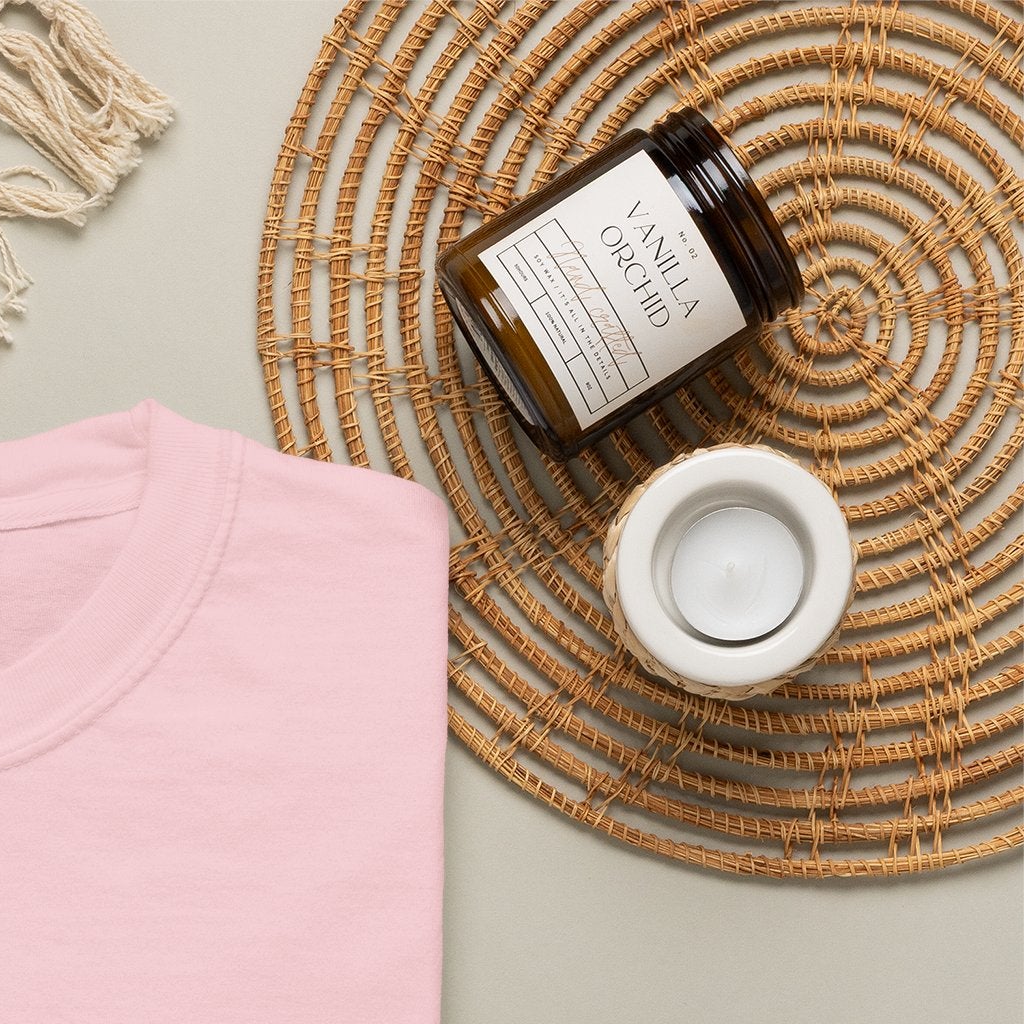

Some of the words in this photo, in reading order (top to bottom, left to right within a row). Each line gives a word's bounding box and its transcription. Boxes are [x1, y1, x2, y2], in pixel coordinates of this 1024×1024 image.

[600, 225, 670, 328] ORCHID
[627, 200, 701, 319] VANILLA
[678, 230, 687, 247] No.
[688, 248, 698, 260] 02
[533, 254, 544, 267] SOY
[544, 269, 554, 283] WAX
[559, 291, 569, 306] IT'S
[569, 309, 578, 322] ALL
[578, 324, 586, 334] IN
[585, 336, 595, 349] THE
[593, 351, 611, 380] DETAILS
